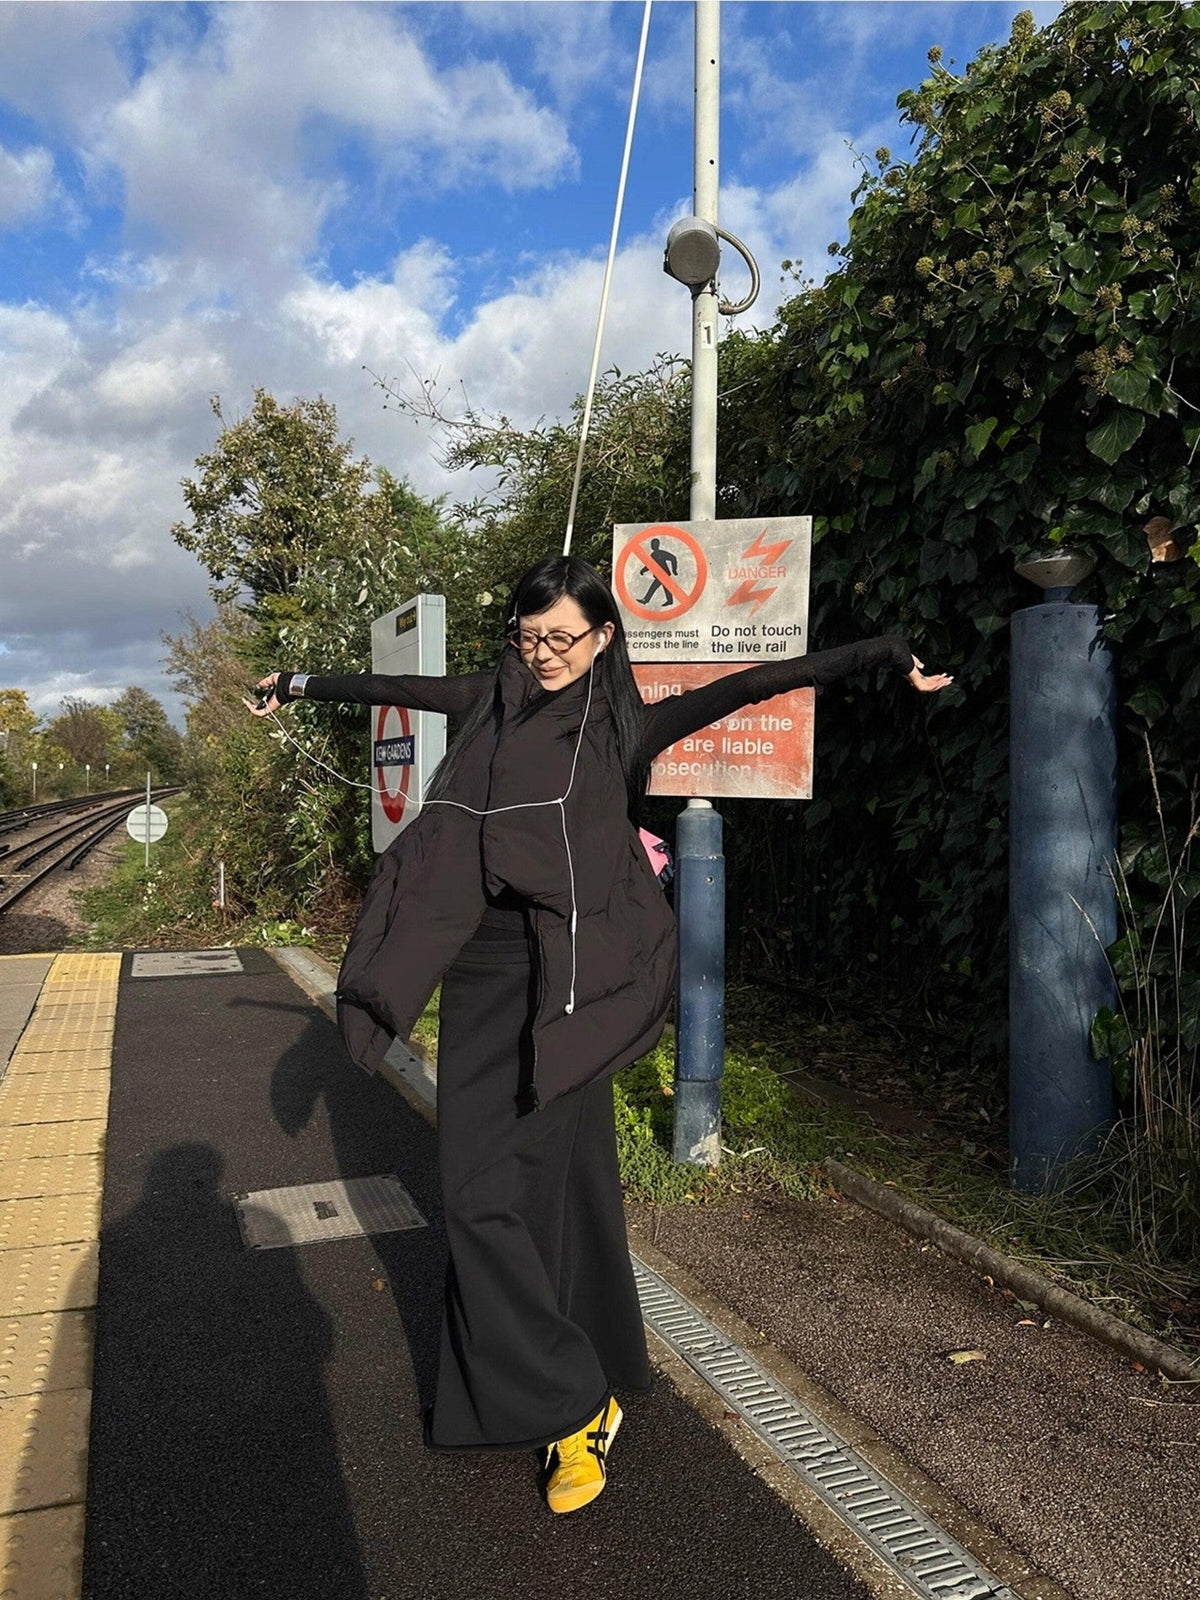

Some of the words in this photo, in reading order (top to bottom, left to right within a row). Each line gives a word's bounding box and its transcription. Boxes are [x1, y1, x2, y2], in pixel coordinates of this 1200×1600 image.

[704, 326, 711, 344] 1
[728, 567, 787, 579] DANGER
[624, 631, 672, 639] ssengers
[675, 630, 699, 638] must
[711, 625, 730, 637] Do
[735, 625, 757, 637] not
[762, 624, 801, 636] touch
[632, 641, 661, 649] cross
[664, 641, 680, 649] the
[682, 641, 699, 649] line
[711, 641, 733, 653] the
[738, 641, 761, 652] live
[766, 641, 786, 652] rail
[640, 681, 681, 699] ning
[761, 715, 792, 731] the
[375, 746, 386, 761] KEW
[386, 742, 411, 760] GARDENS
[683, 739, 714, 752] are
[722, 738, 774, 755] liable
[652, 760, 751, 776] osecution
